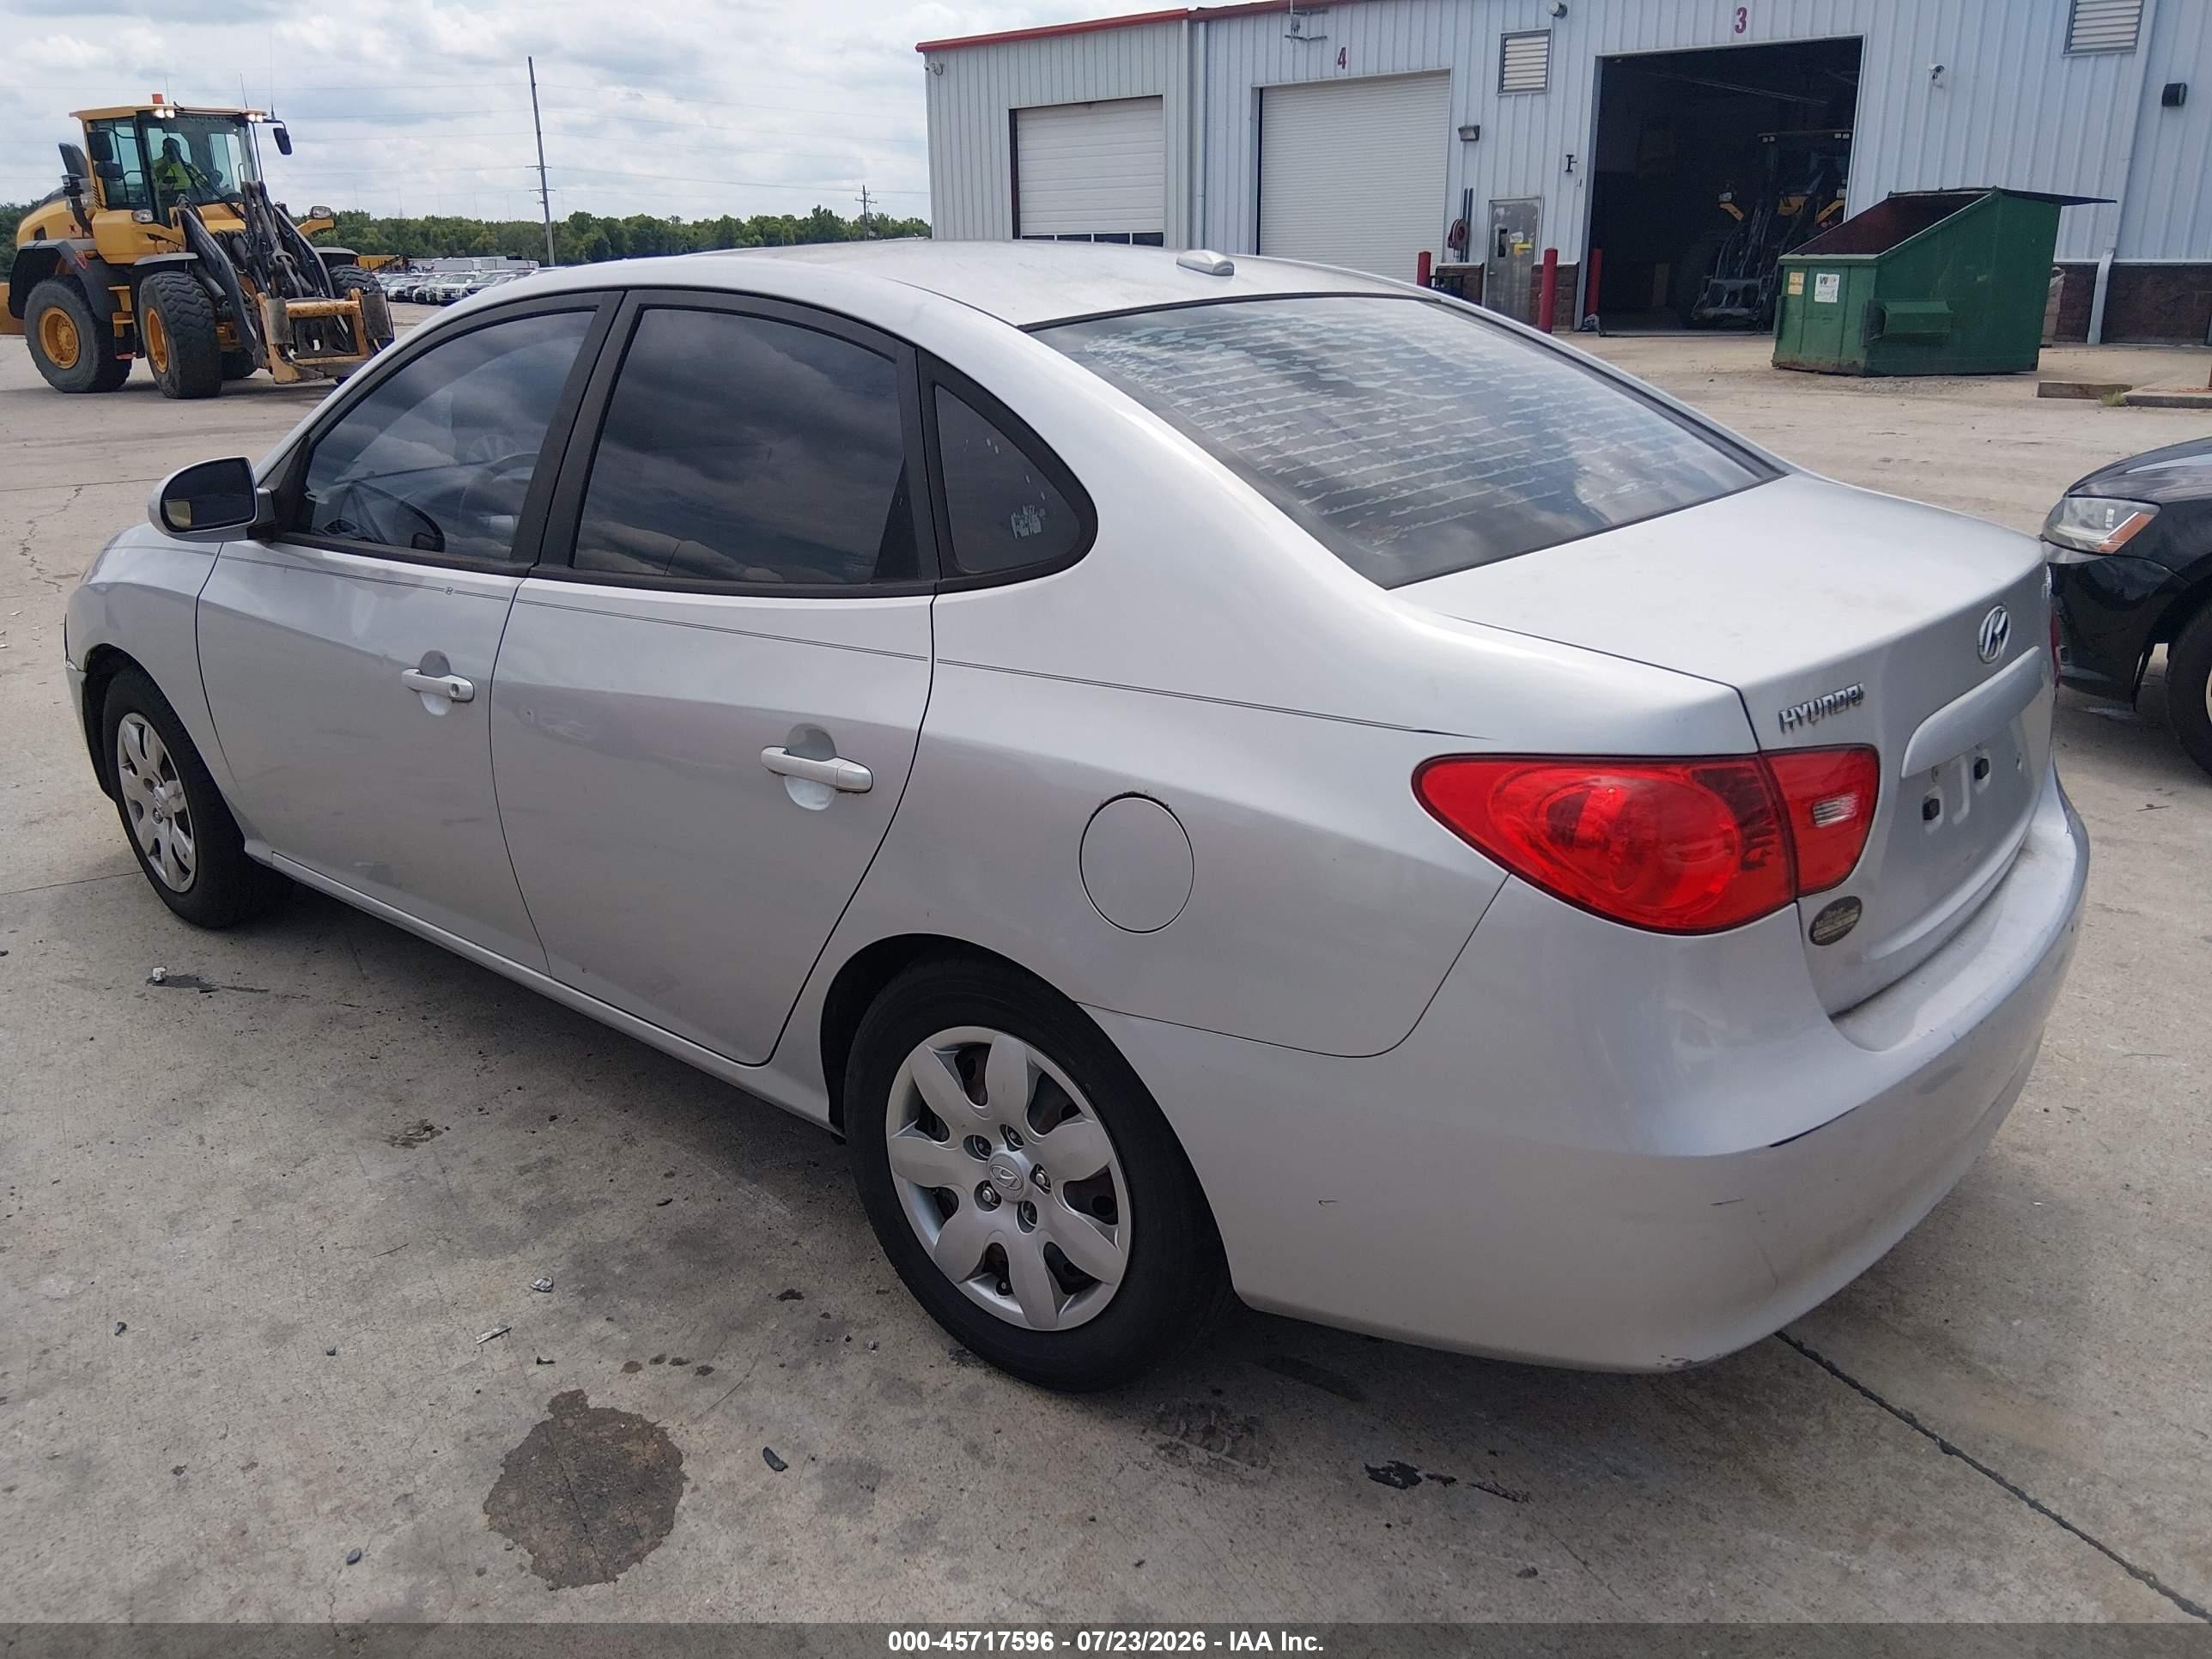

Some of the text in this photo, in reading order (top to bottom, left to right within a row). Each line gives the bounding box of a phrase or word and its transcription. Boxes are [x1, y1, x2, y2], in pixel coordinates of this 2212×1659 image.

[1735, 7, 1747, 33] 3
[1337, 46, 1346, 70] 4
[1778, 682, 1864, 735] HYUNDAI
